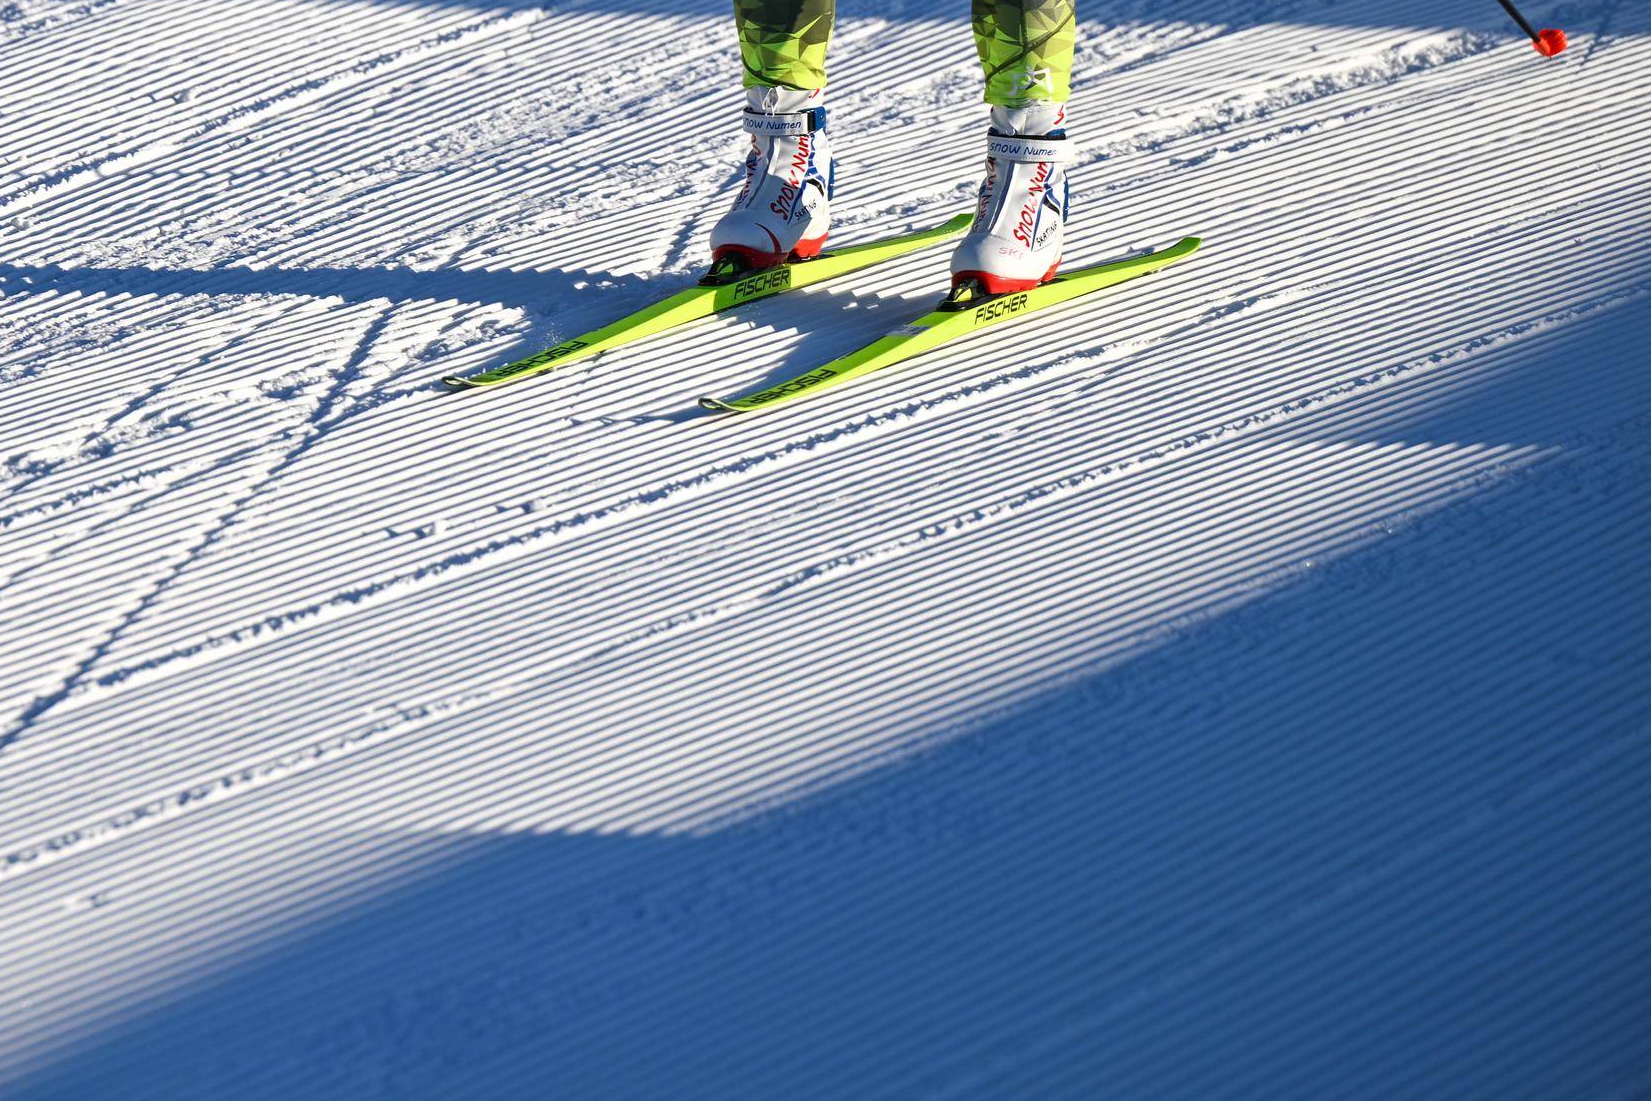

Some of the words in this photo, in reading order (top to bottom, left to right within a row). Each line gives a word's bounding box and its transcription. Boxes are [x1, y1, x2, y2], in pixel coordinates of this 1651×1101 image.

[766, 121, 802, 130] Numen
[990, 142, 1022, 155] snow
[770, 169, 800, 221] Snow
[734, 268, 790, 300] FISCHER
[974, 293, 1028, 325] FISCHER
[496, 340, 589, 378] FISCHER
[749, 368, 837, 404] FISCHER
